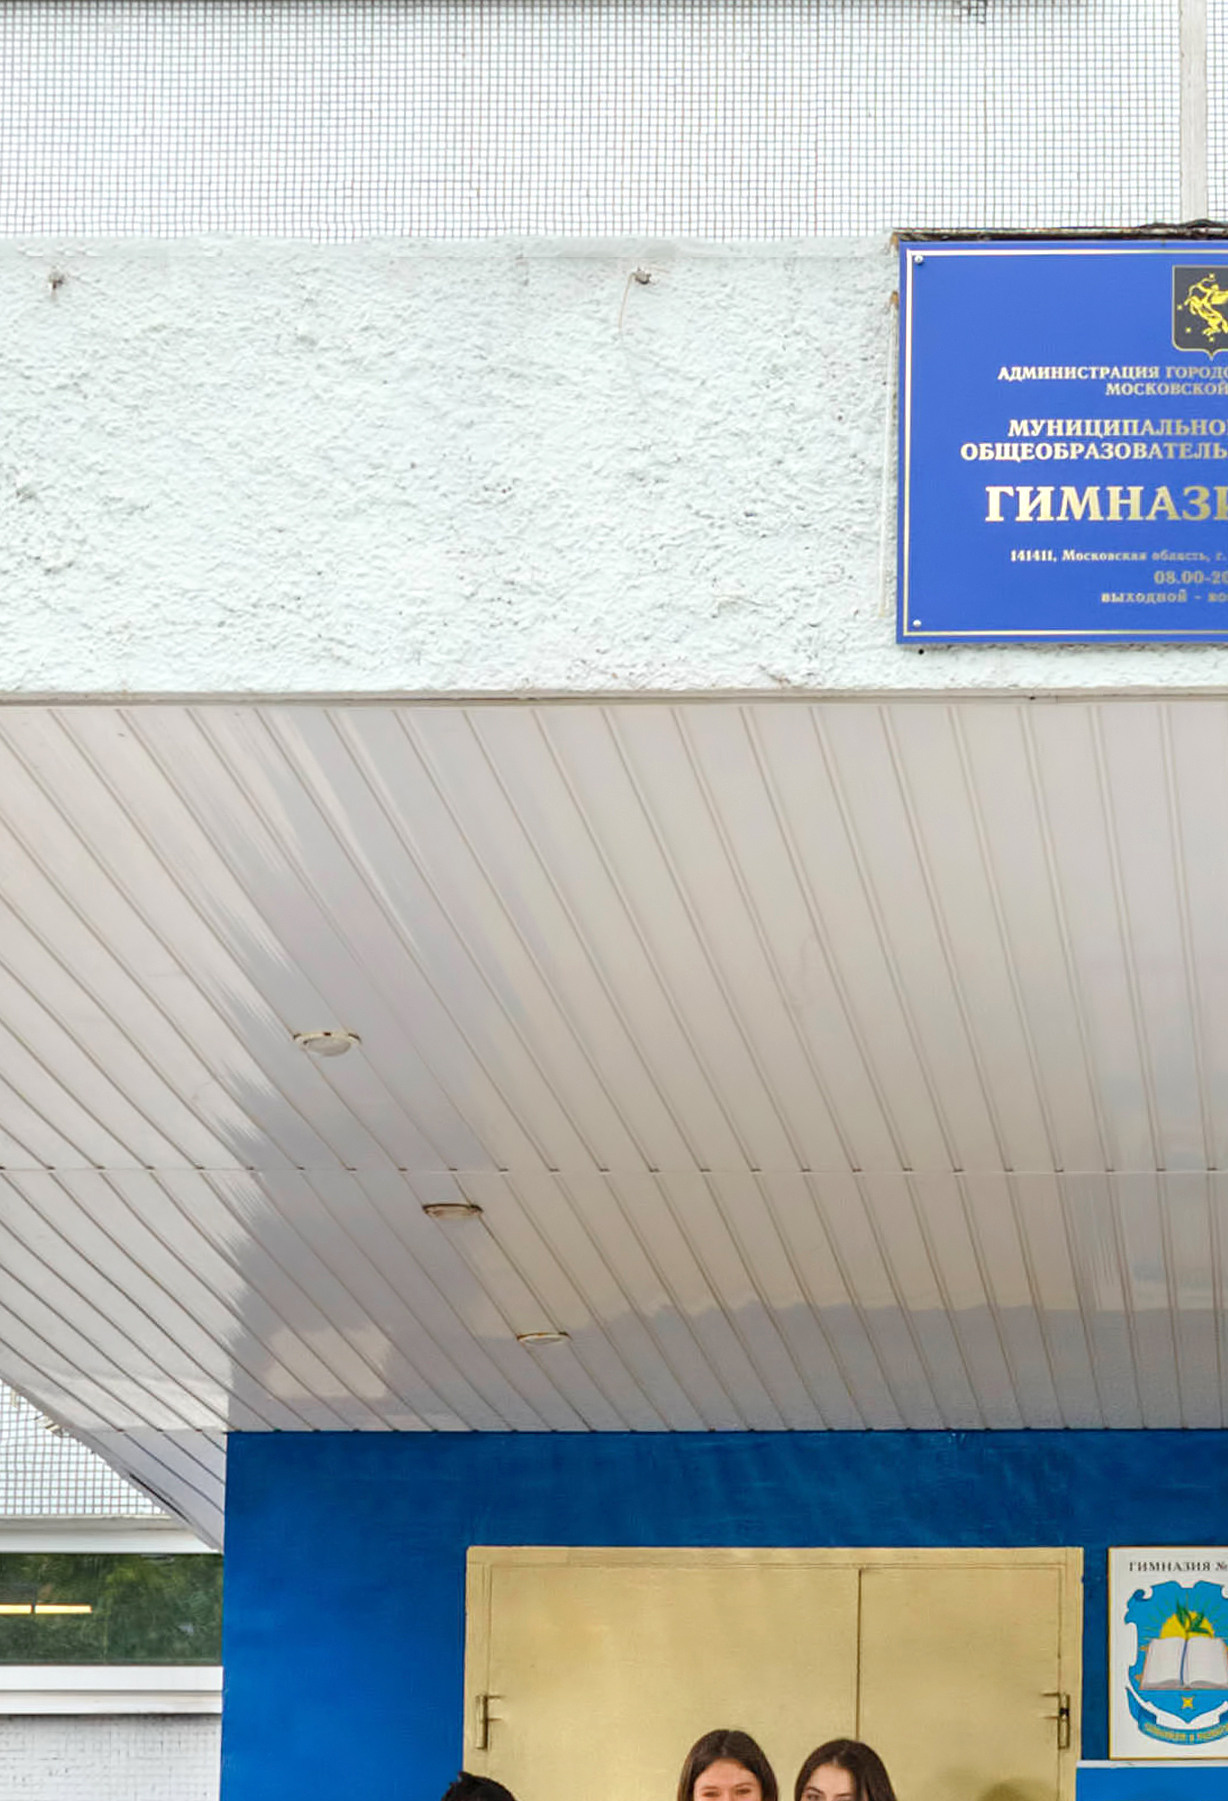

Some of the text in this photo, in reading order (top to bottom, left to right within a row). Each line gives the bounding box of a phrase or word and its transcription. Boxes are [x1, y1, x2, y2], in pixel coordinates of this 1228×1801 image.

[997, 366, 1160, 382] АДМИНИСТРАЦИЯ
[1010, 549, 1057, 563] 141411,
[1062, 549, 1148, 562] Московская
[1151, 549, 1211, 563] область,
[1215, 552, 1227, 562] г.
[1099, 588, 1188, 605] выходной
[1129, 1561, 1211, 1573] ГИМНАЗИЯ
